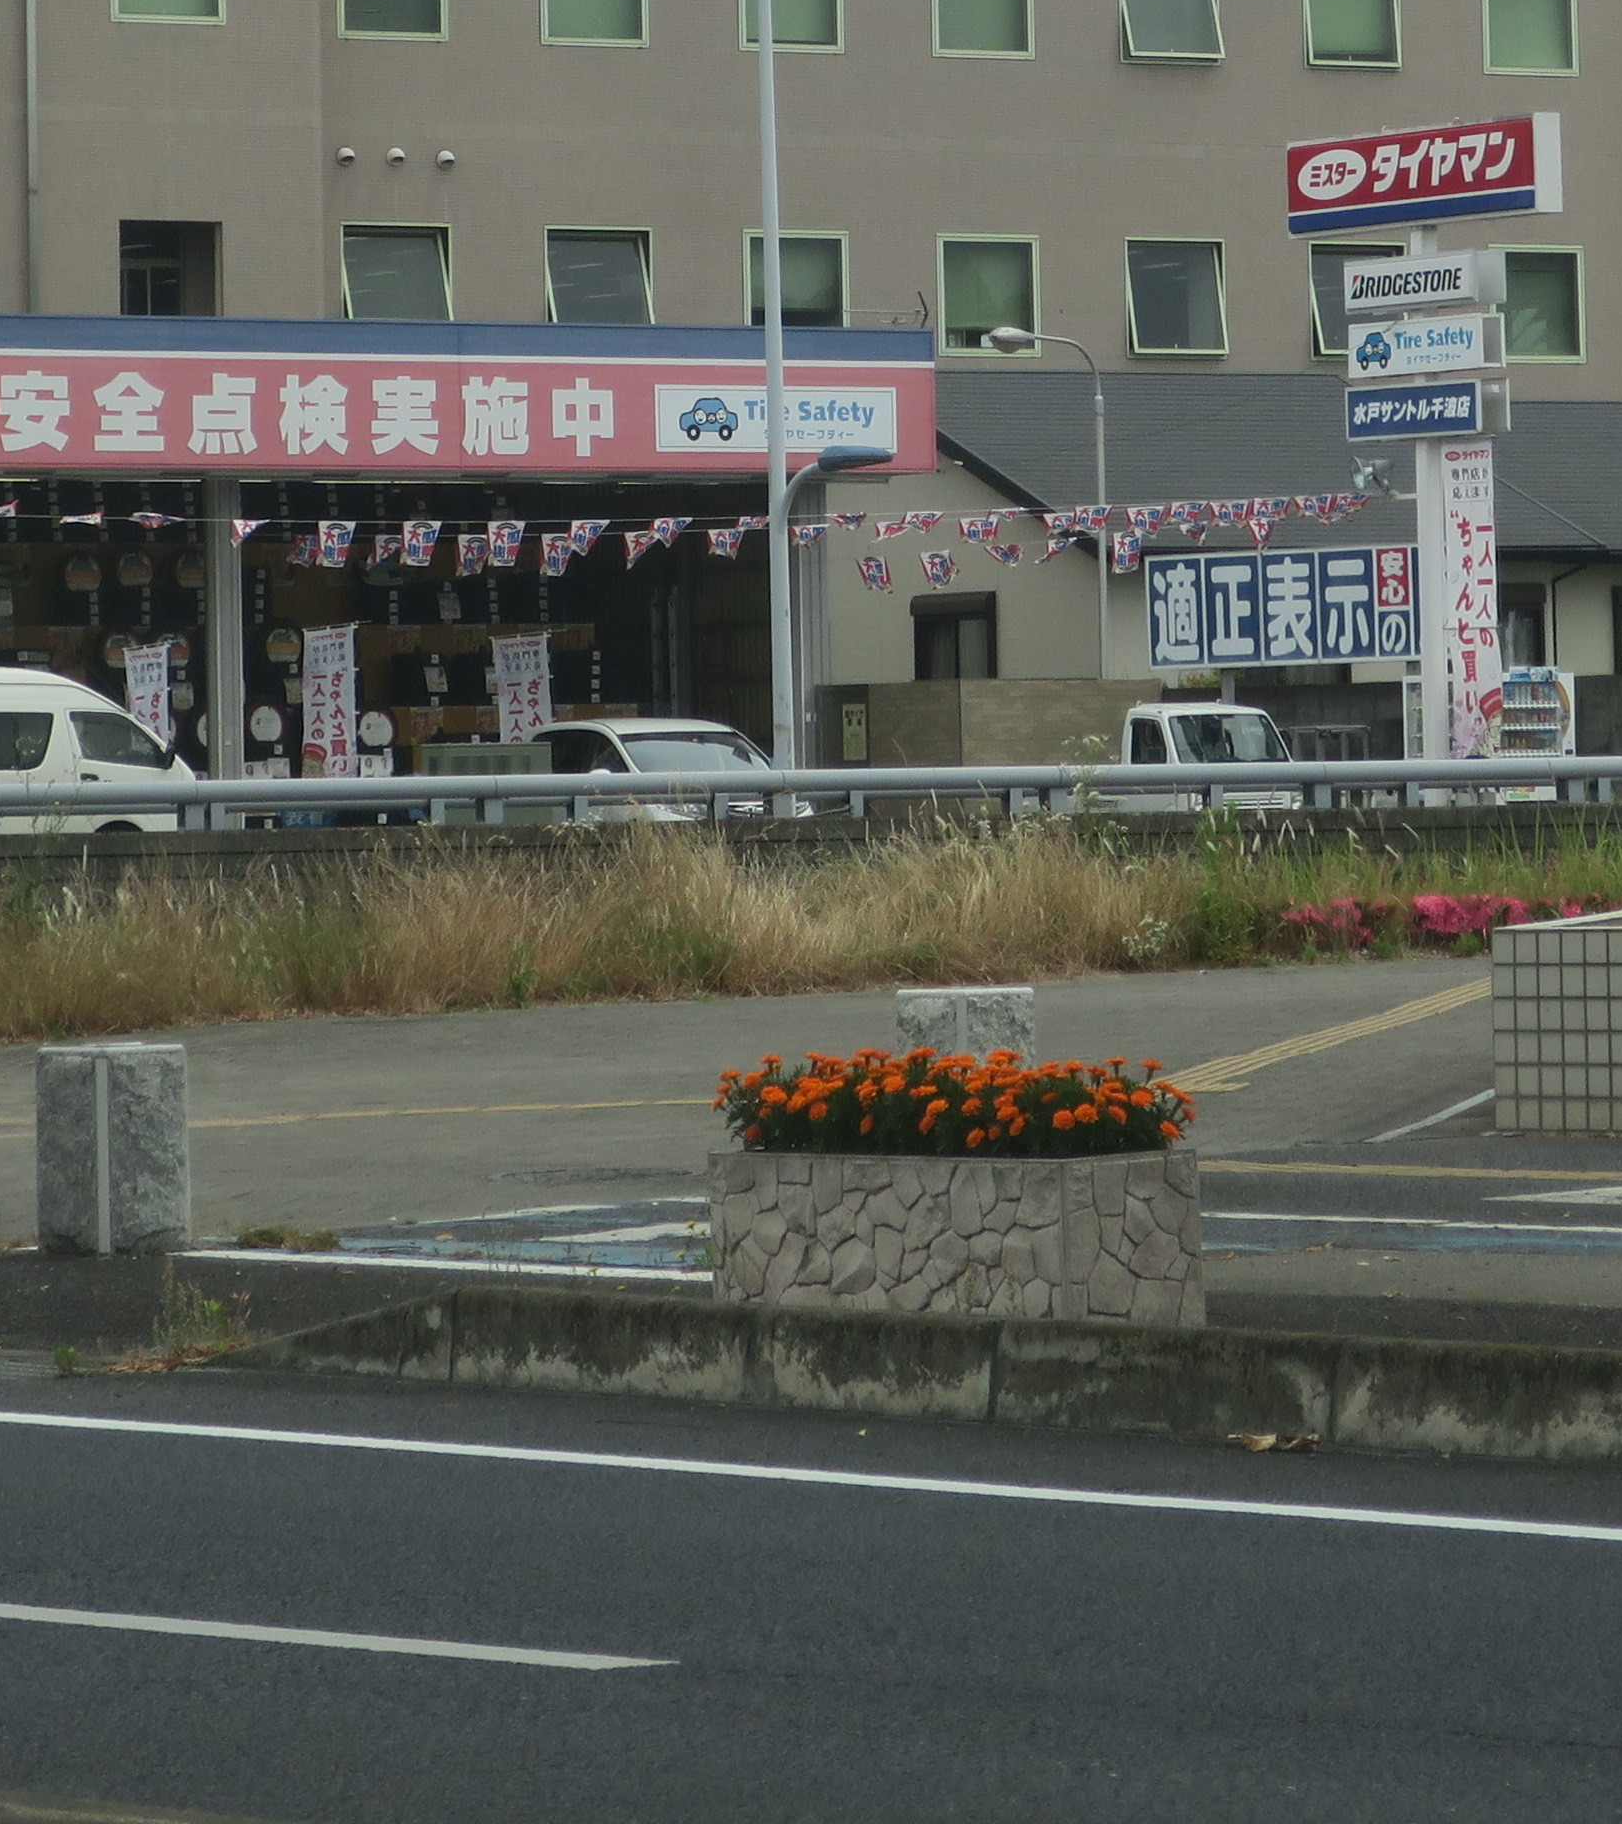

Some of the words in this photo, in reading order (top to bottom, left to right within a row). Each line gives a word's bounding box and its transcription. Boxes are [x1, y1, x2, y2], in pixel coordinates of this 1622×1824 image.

[1308, 161, 1358, 188] ミスター
[1372, 130, 1516, 194] タイヤマン
[1350, 267, 1462, 300] BRIDGESTONE
[1394, 330, 1423, 350] Tire
[1426, 326, 1474, 350] Safety
[744, 399, 790, 422] Tie
[798, 399, 876, 429] Safety
[1152, 555, 1371, 662] 適正表示
[1475, 524, 1494, 648] 一人一人の
